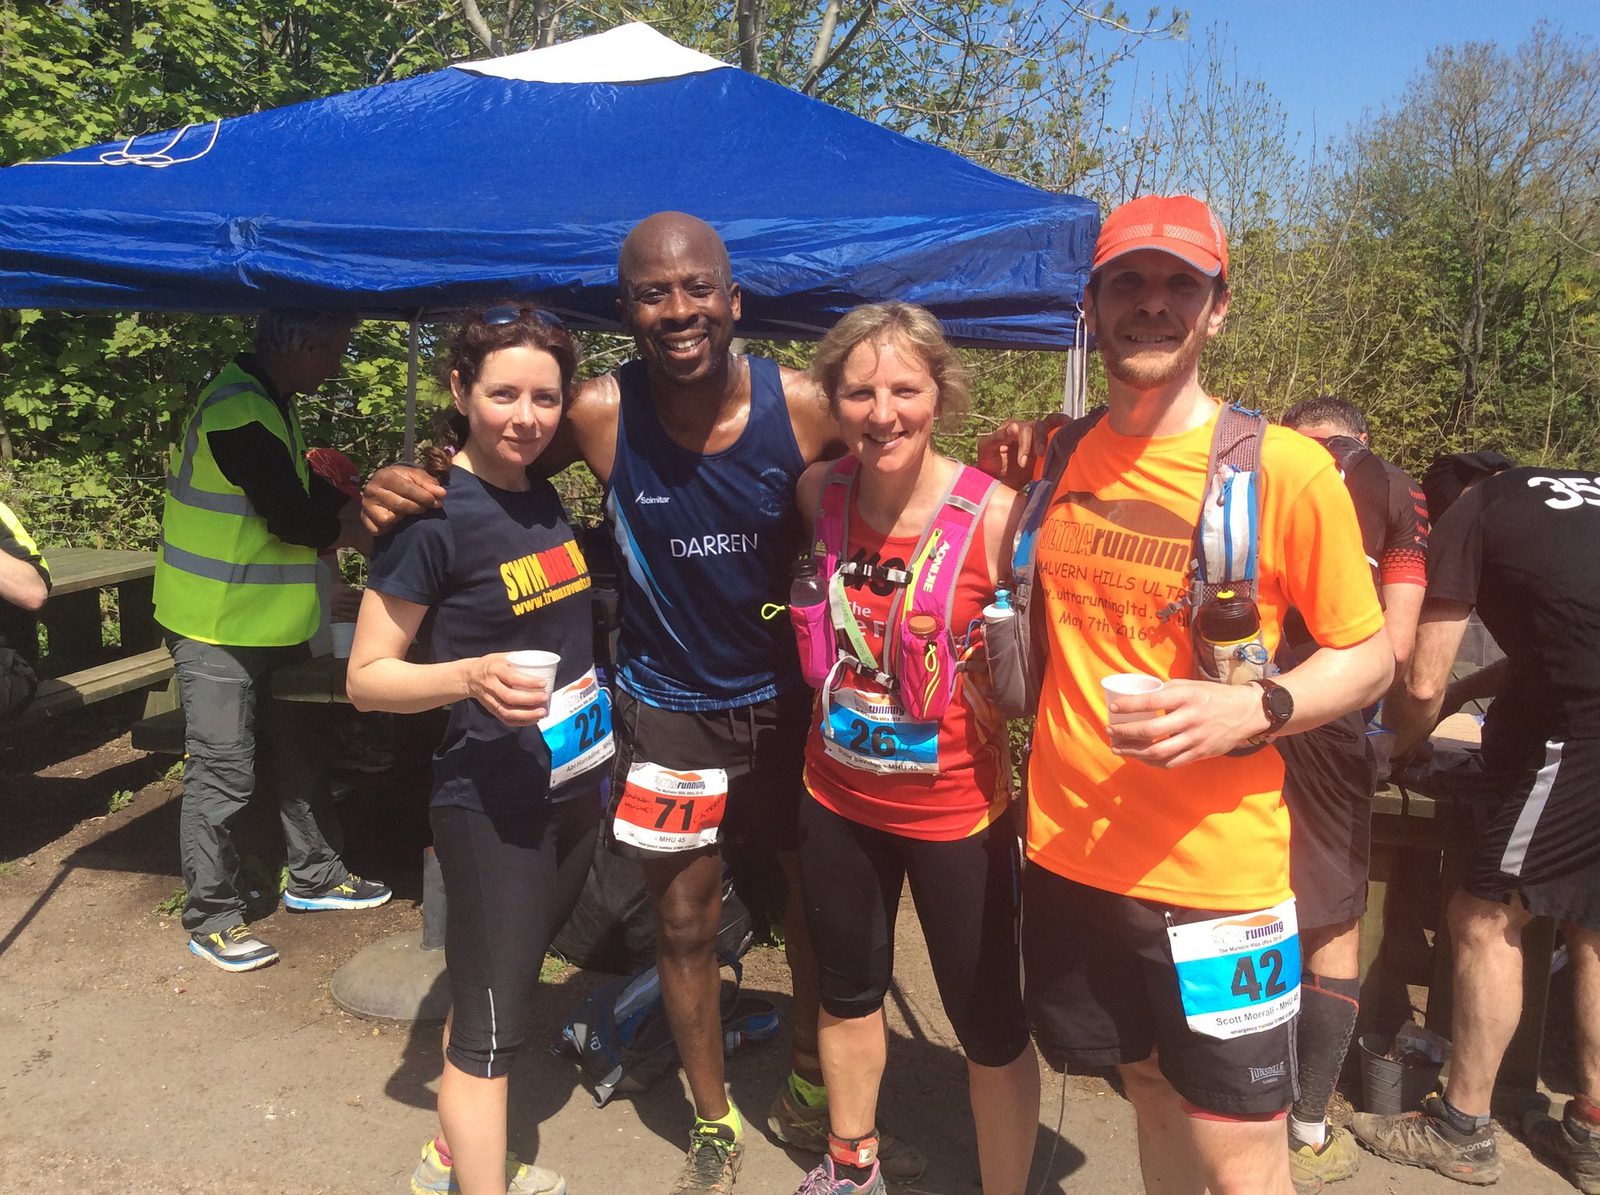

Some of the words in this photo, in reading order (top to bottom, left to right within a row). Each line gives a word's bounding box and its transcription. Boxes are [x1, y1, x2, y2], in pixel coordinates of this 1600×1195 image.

[641, 496, 670, 505] Scimitar
[669, 533, 758, 558] DARREN
[1039, 518, 1187, 574] ULTRArunnin
[1093, 568, 1136, 591] HILLS
[1143, 580, 1187, 602] ULTR
[849, 601, 872, 617] he
[1058, 612, 1083, 630] May
[1087, 616, 1110, 634] 7th
[574, 703, 606, 752] 22
[849, 718, 896, 758] 26
[654, 796, 695, 831] 71
[658, 835, 676, 843] MHU
[1245, 921, 1284, 940] running
[1231, 949, 1286, 1002] 42
[1215, 1016, 1242, 1027] Scott
